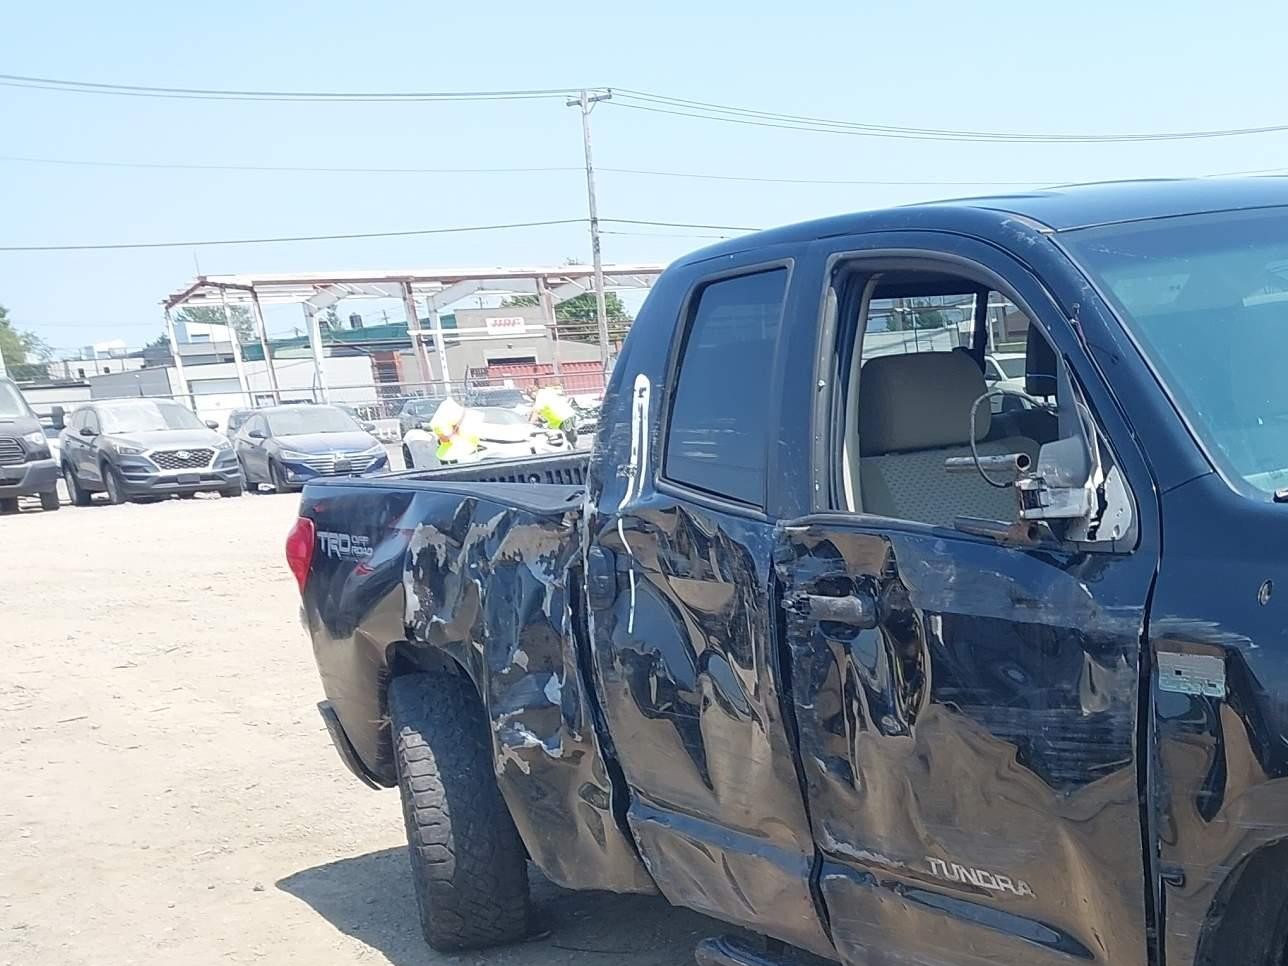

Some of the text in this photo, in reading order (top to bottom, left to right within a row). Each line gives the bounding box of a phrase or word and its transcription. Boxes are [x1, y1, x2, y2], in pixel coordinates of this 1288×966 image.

[316, 531, 369, 560] TRD OFF
[351, 545, 374, 559] ROAD
[925, 855, 1038, 899] TUNDRA
